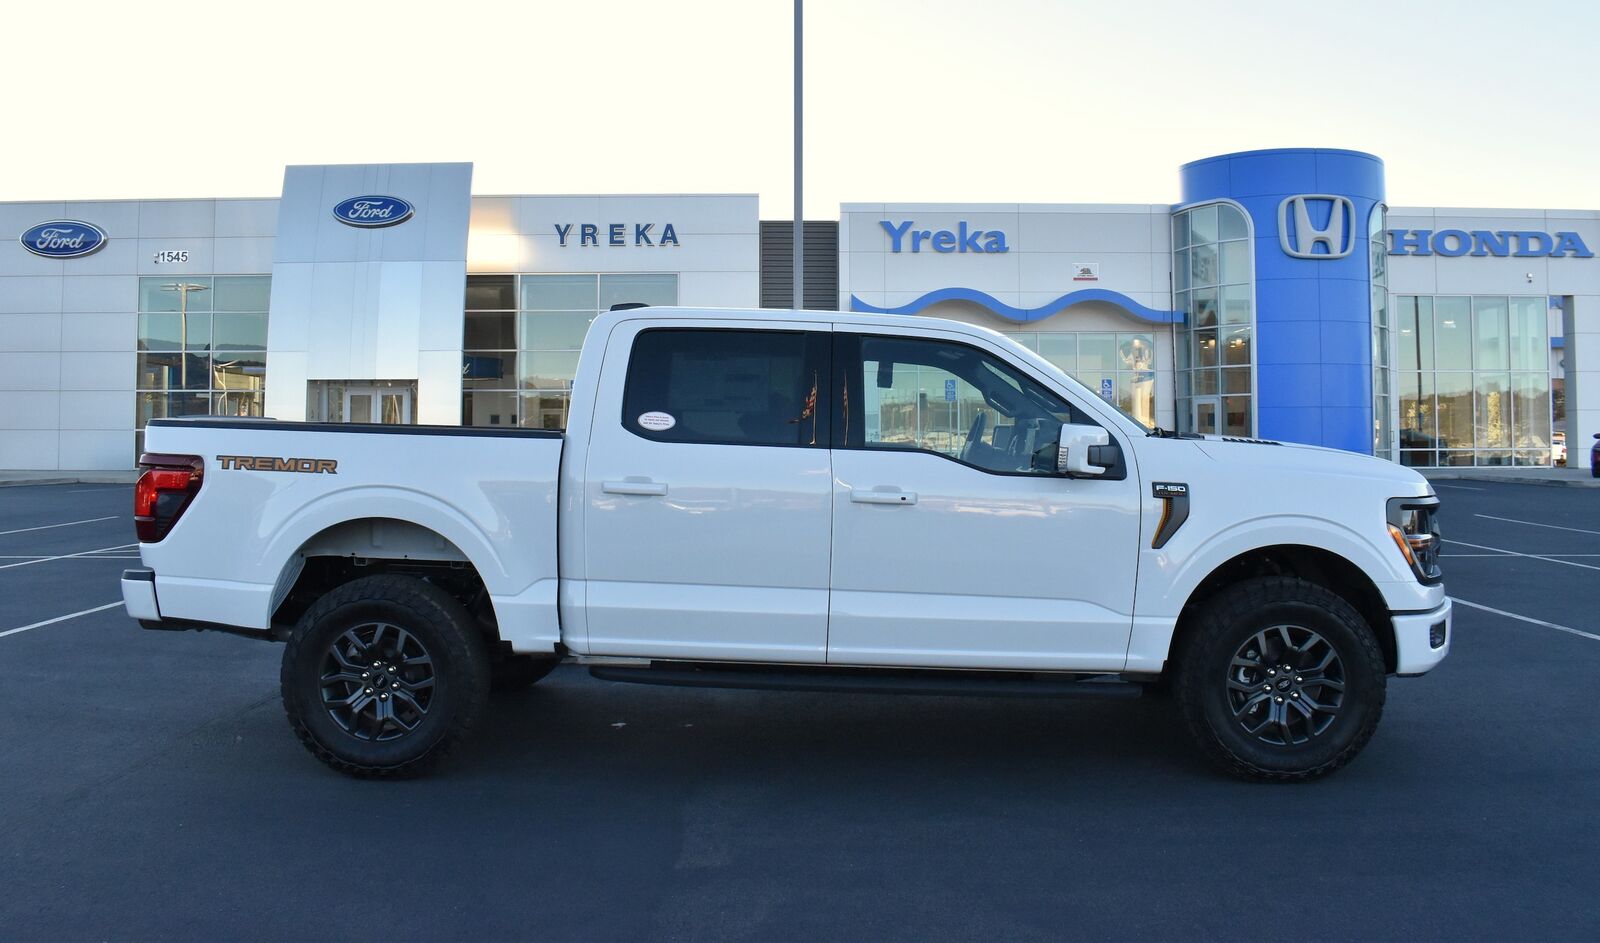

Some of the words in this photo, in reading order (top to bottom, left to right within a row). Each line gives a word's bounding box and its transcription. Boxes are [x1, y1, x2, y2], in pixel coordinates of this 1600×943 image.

[348, 200, 394, 218] Ford
[36, 228, 85, 249] Ford
[554, 223, 680, 247] YREKA
[879, 221, 1009, 254] Yreka
[1387, 229, 1594, 258] HONDA
[160, 251, 189, 263] 1545
[216, 455, 338, 475] TREMOR
